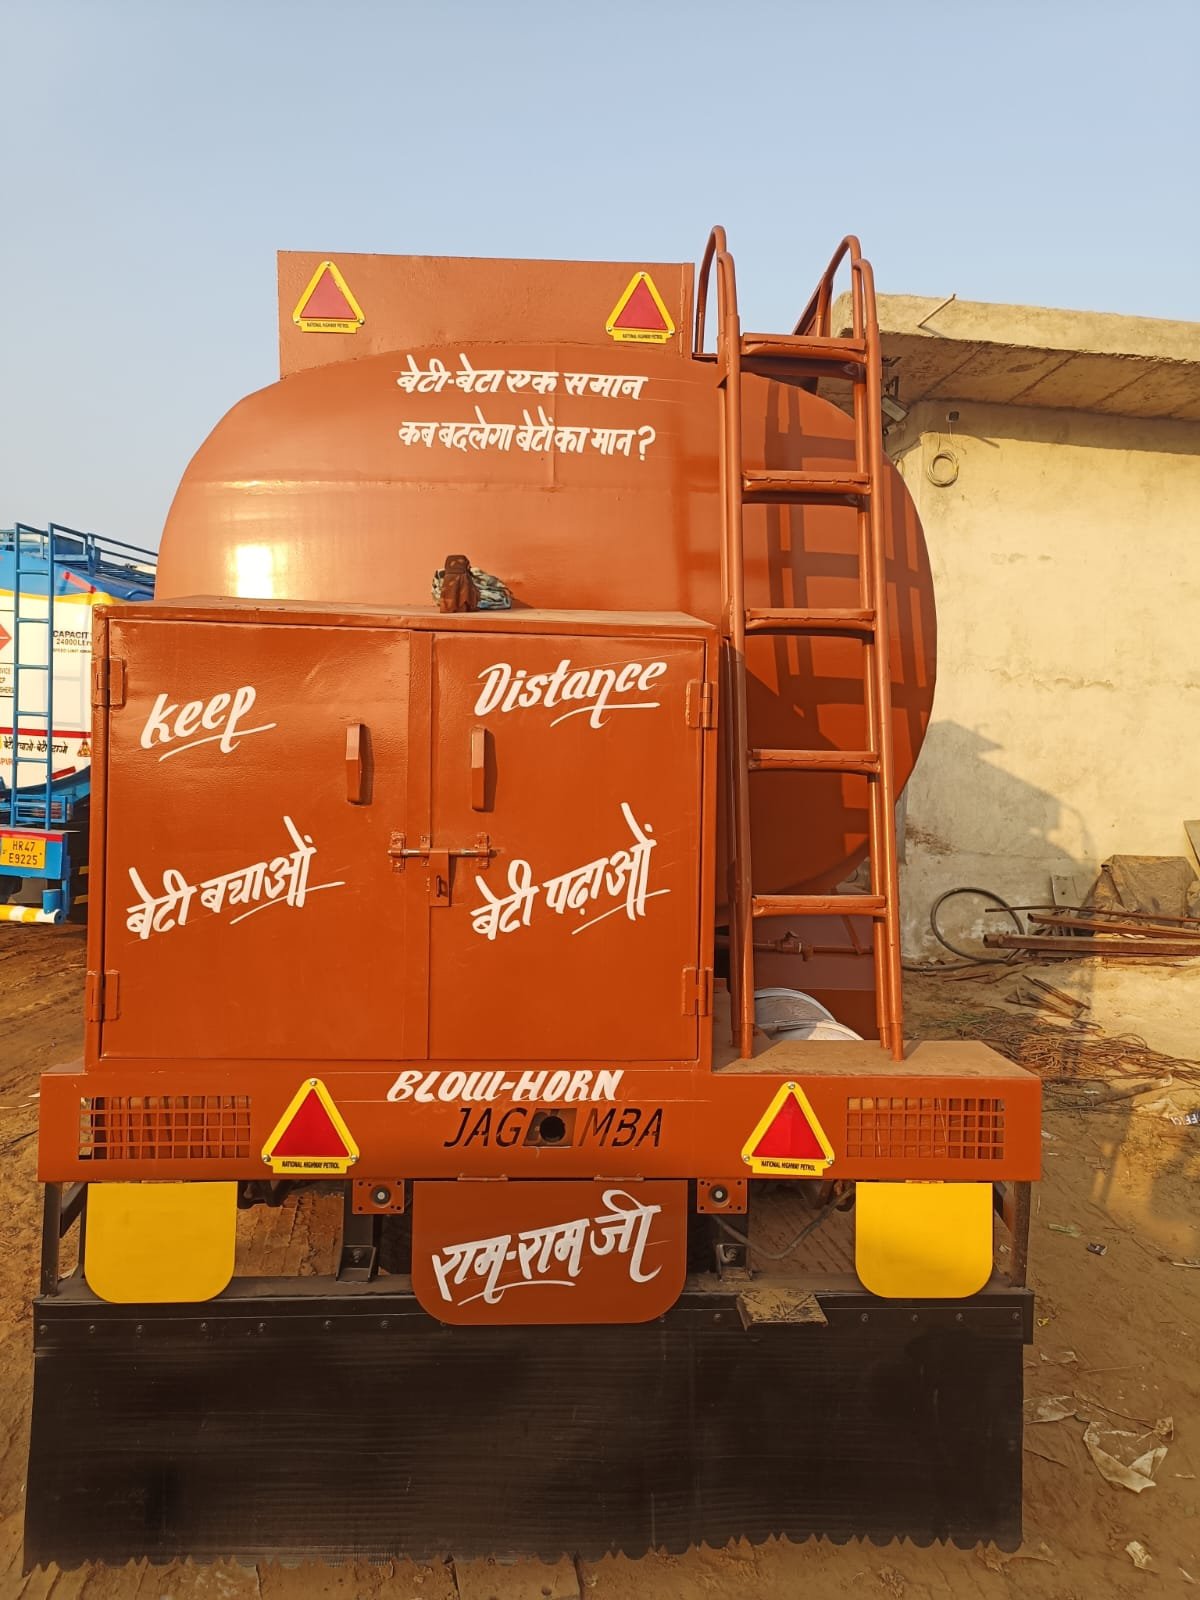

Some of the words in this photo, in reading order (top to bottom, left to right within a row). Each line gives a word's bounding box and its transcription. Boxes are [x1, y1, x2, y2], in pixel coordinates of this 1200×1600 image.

[396, 352, 506, 394] बेटी-बेटा
[564, 372, 649, 400] समान
[398, 420, 440, 448] कब
[438, 405, 517, 453] बदलेगा
[554, 425, 591, 454] का
[53, 630, 92, 639] CAPACIT
[474, 659, 668, 729] Distance
[8, 852, 38, 865] E9225
[13, 840, 36, 852] HR47
[126, 866, 197, 940] बेटी
[470, 859, 541, 941] बेटी
[386, 1069, 625, 1103] BLOW-HORN
[281, 1160, 303, 1168] NATIONAL
[761, 1160, 782, 1169] NATIONAL
[431, 1218, 591, 1306] राम-राम
[588, 1188, 663, 1284] जी
